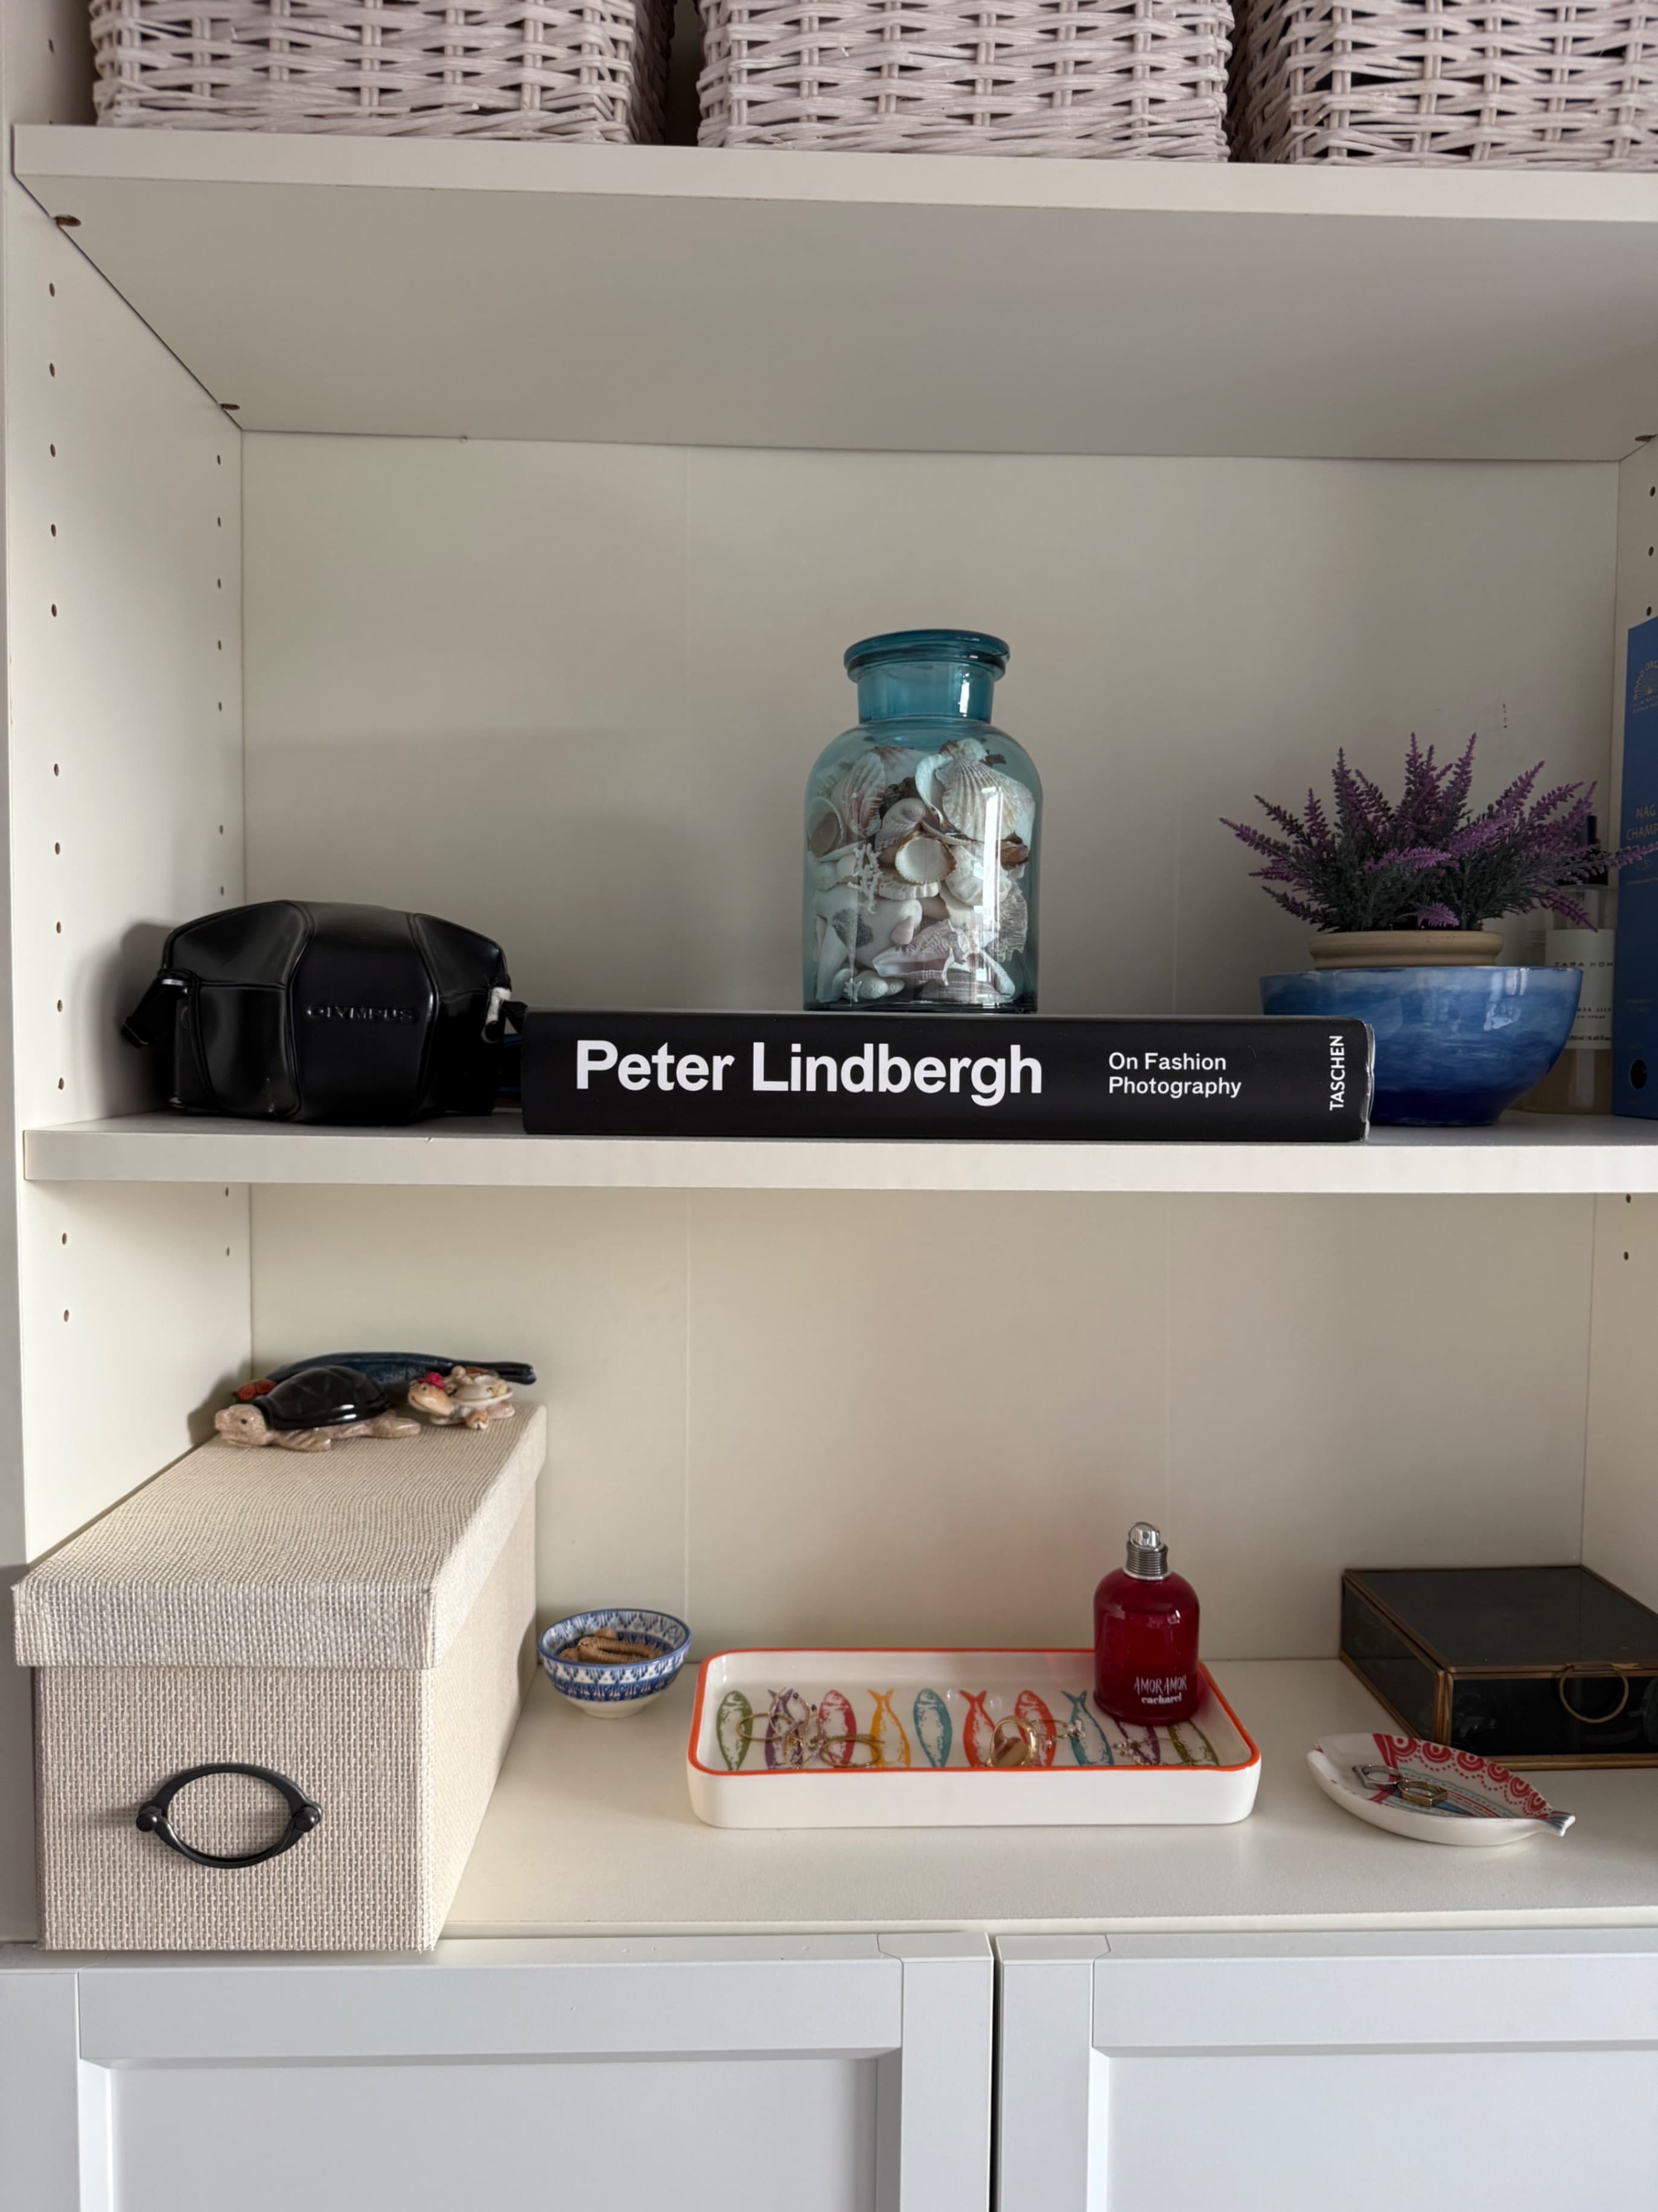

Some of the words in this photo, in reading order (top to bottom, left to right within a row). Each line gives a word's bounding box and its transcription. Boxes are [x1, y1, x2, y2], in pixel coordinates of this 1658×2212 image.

[1636, 804, 1656, 820] NAG
[1627, 823, 1658, 840] CHAMP
[307, 1005, 415, 1021] OLYMPUS
[1108, 1052, 1138, 1070] On
[1144, 1052, 1227, 1070] Fashion
[577, 1040, 735, 1091] Peter
[752, 1041, 1042, 1107] Lindbergh
[1329, 1035, 1345, 1111] TASCHEN
[1108, 1076, 1242, 1098] Photography
[1134, 1676, 1163, 1695] AMOR
[1164, 1674, 1187, 1695] AMOR
[1141, 1692, 1182, 1704] cacharel
